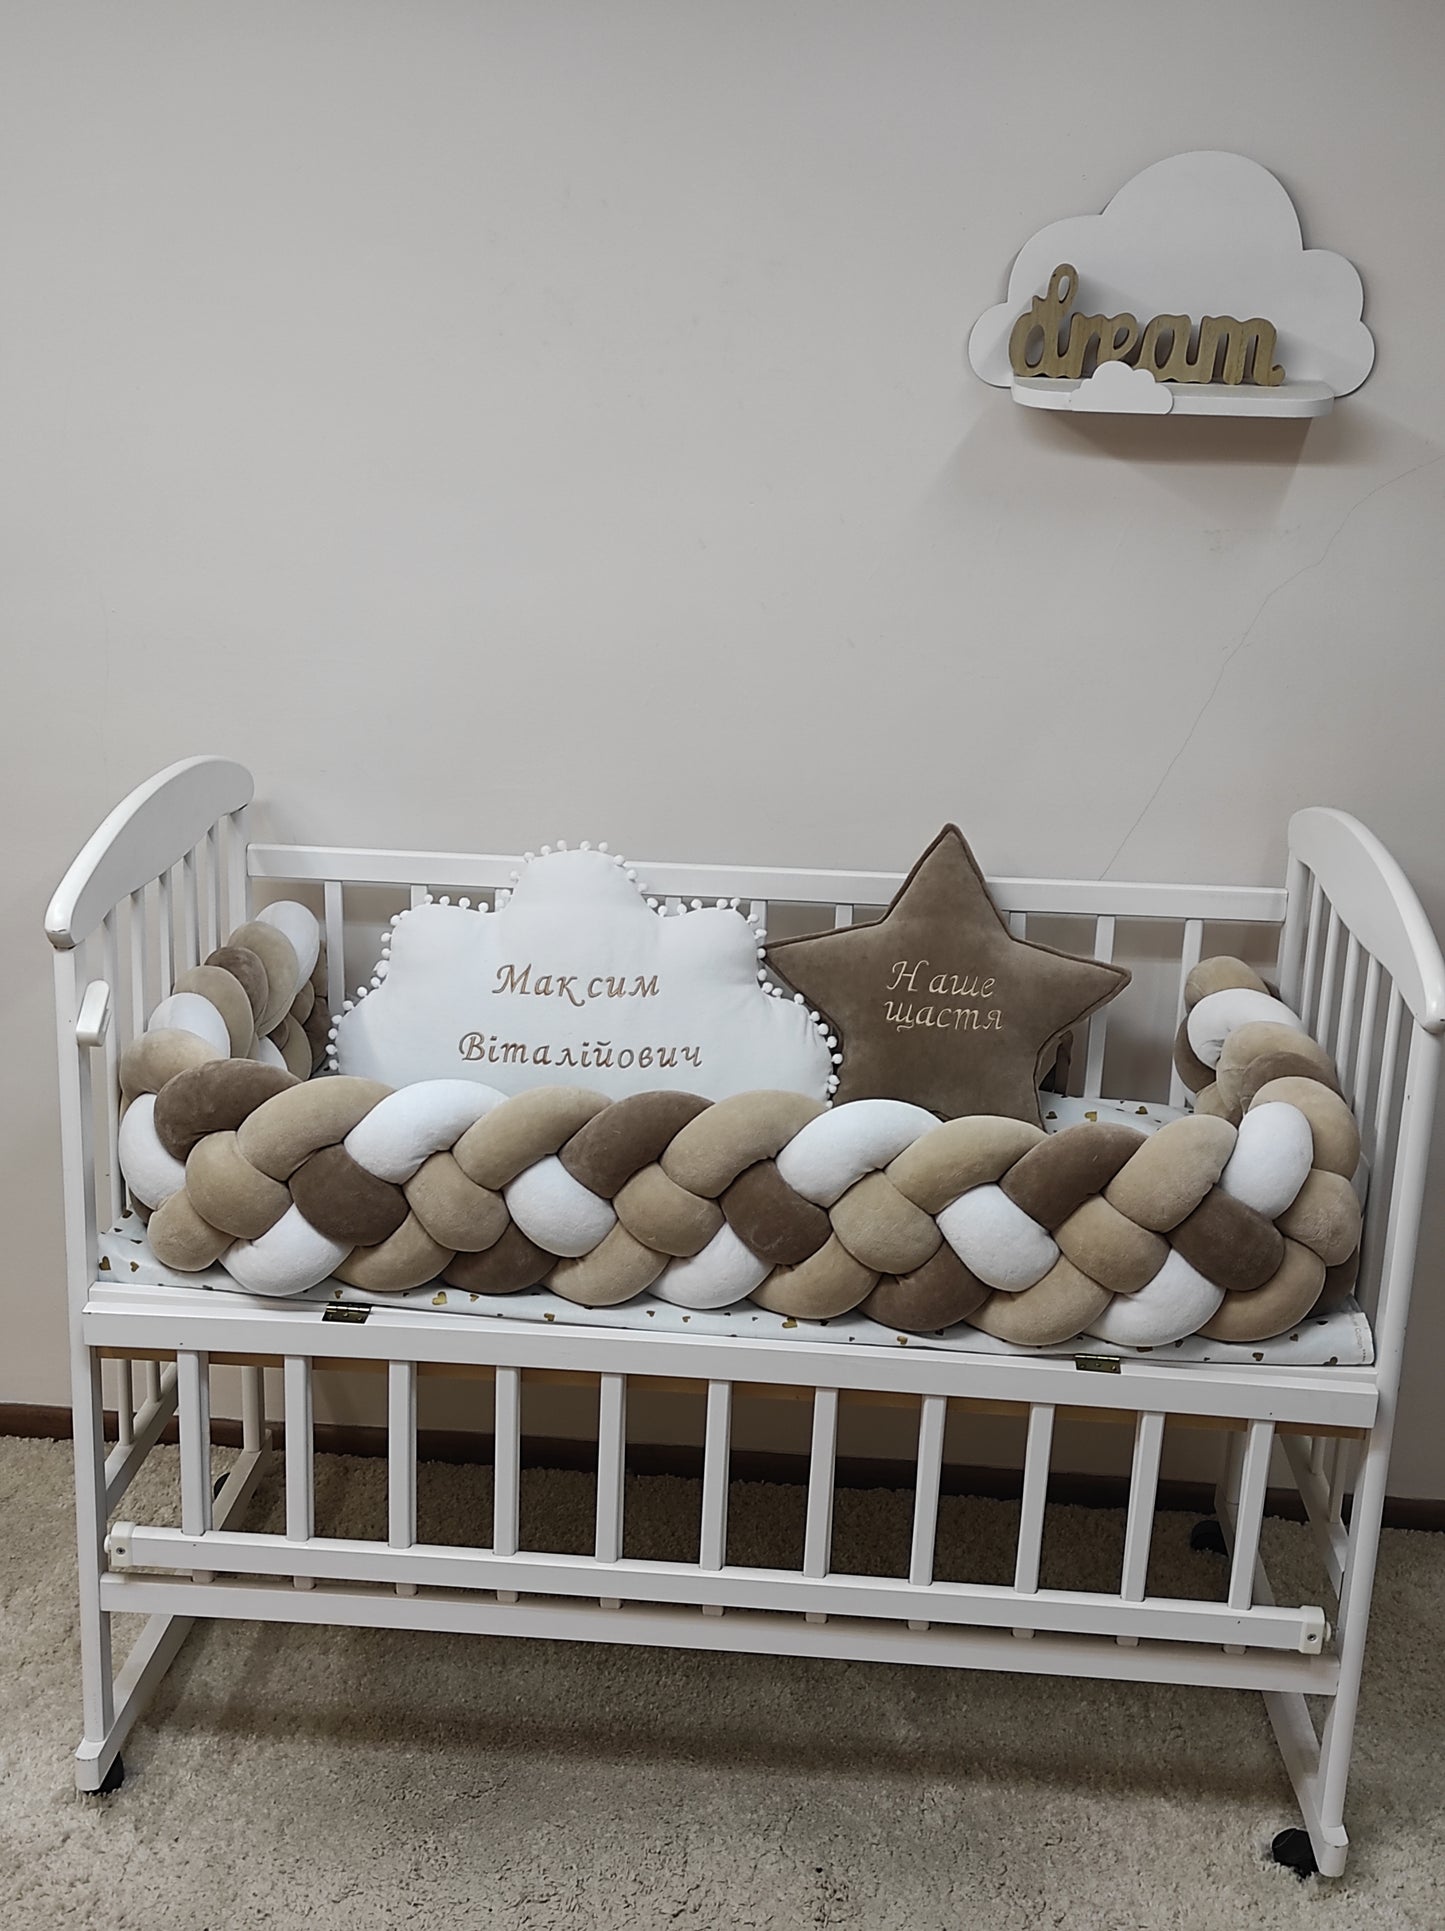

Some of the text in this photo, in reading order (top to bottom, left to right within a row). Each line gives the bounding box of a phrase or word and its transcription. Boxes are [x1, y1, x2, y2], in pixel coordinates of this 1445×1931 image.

[1008, 263, 1286, 386] dream
[491, 963, 660, 1007] Максим
[886, 959, 996, 998] Наше
[883, 1000, 1003, 1032] щастя
[458, 1031, 703, 1069] Віталійович
